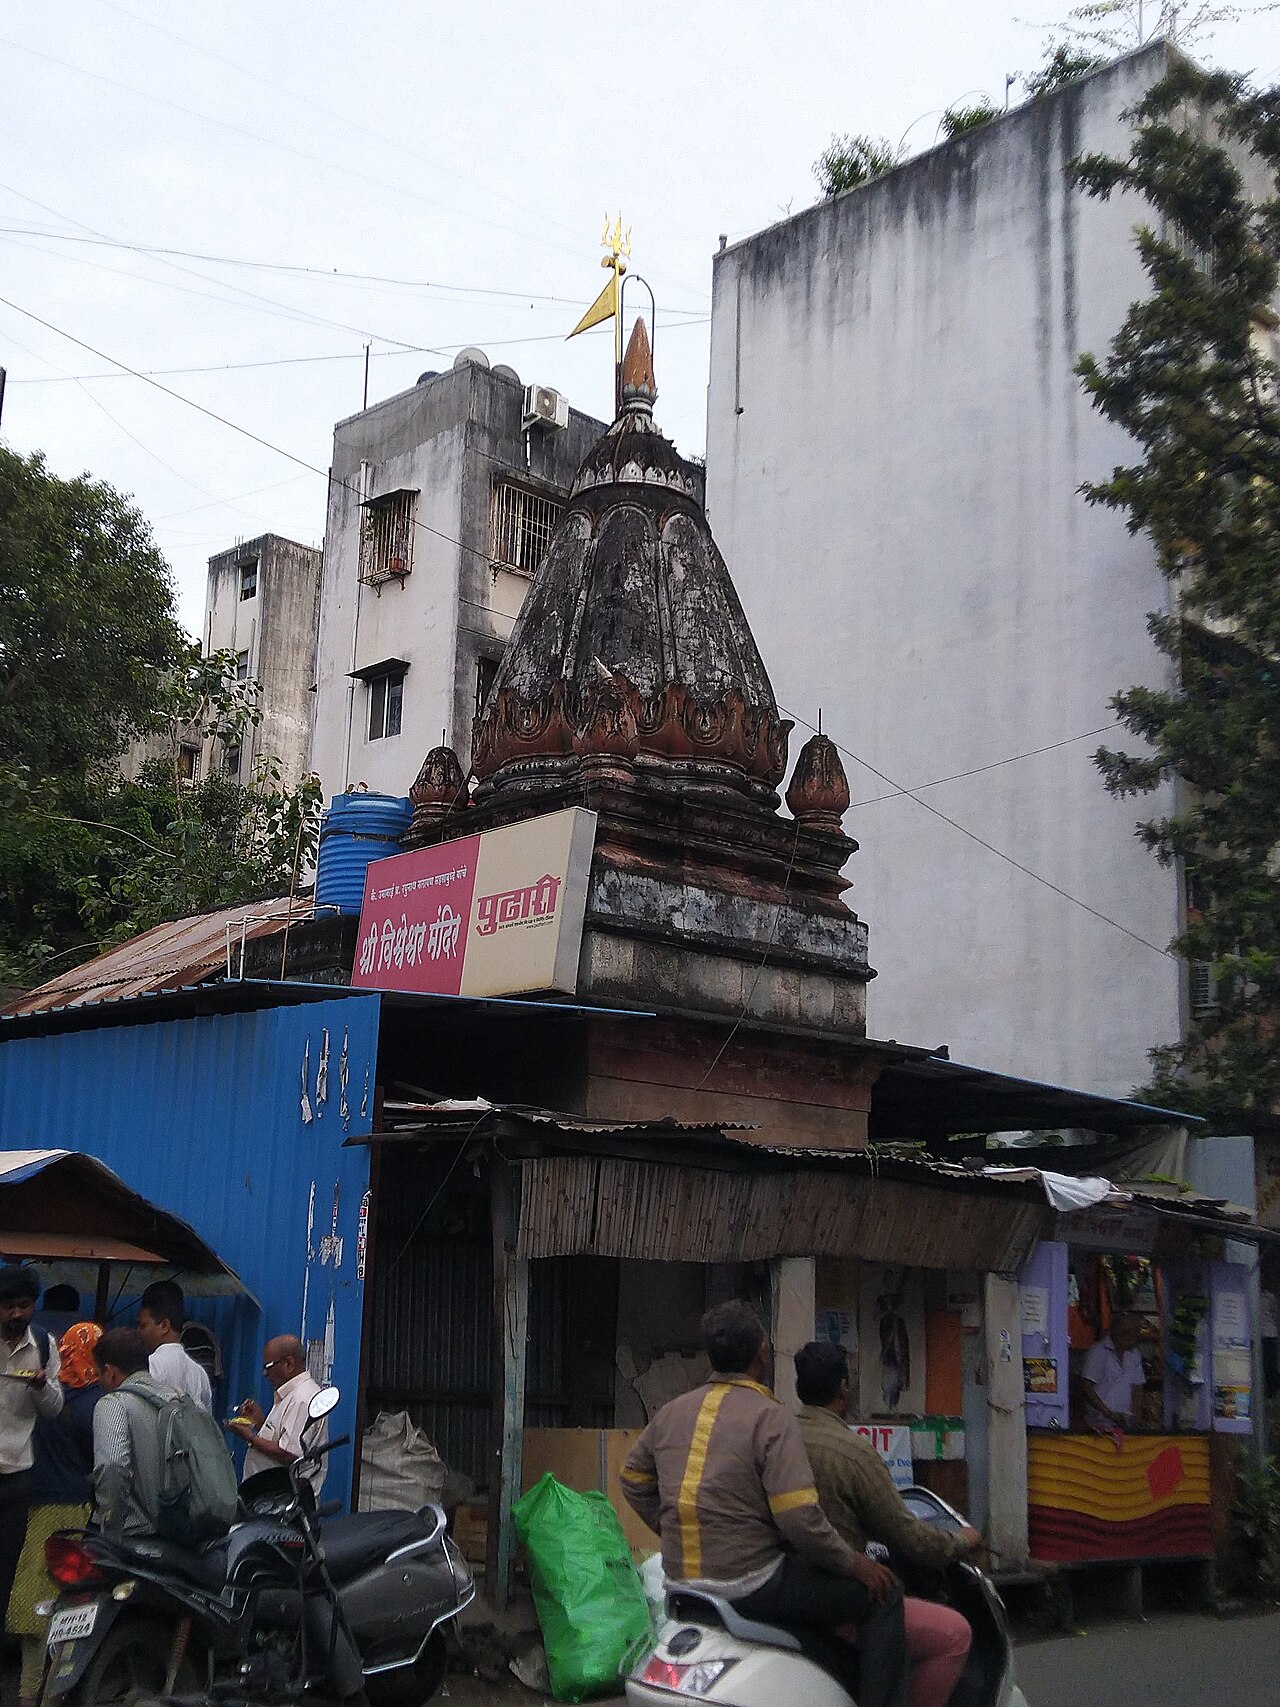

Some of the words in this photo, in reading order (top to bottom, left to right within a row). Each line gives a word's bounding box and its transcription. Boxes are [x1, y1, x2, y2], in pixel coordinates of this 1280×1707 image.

[476, 874, 561, 936] पुढारी
[360, 922, 378, 975] श्री
[378, 913, 426, 969] विश्वेश्वर
[428, 904, 462, 960] मंदिर
